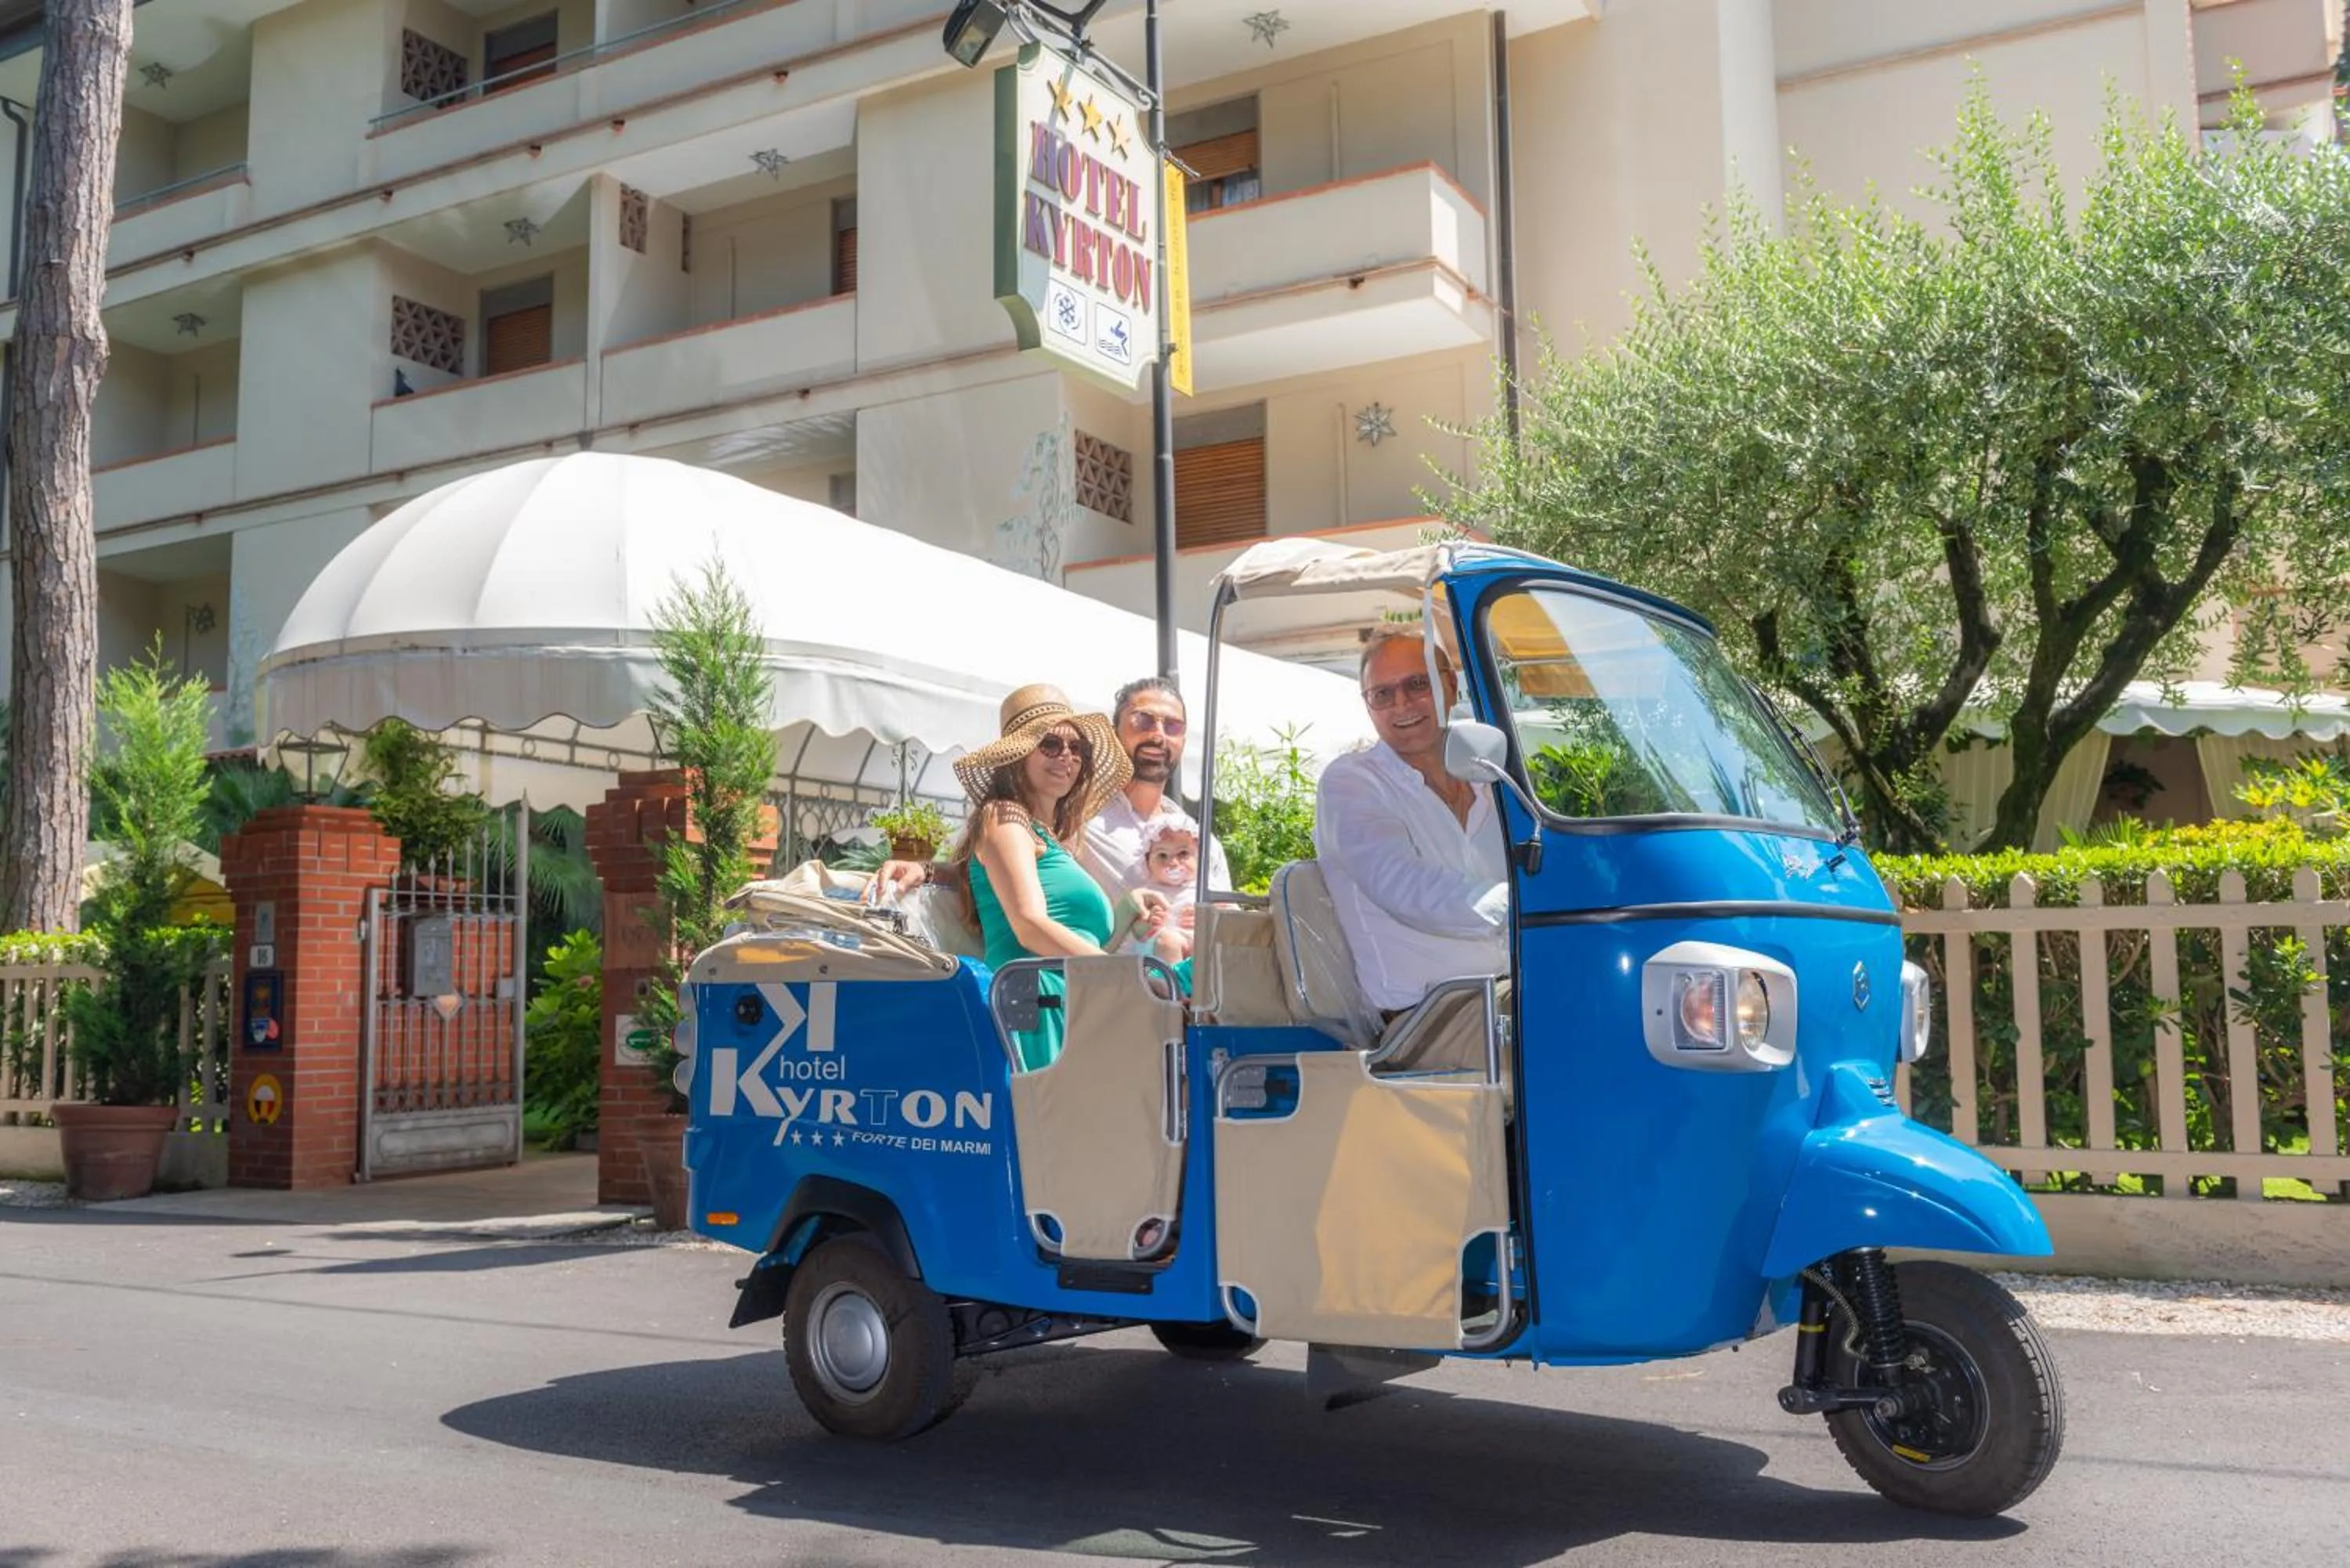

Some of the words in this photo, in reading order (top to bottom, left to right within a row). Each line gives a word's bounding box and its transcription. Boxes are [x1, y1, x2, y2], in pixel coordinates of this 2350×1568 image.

[1030, 121, 1146, 243] HOTEL
[1024, 190, 1153, 315] KYRTON
[779, 1055, 846, 1081] hotel
[851, 1131, 908, 1149] FORTE
[910, 1136, 936, 1151] DEI
[940, 1140, 992, 1156] MARMI
